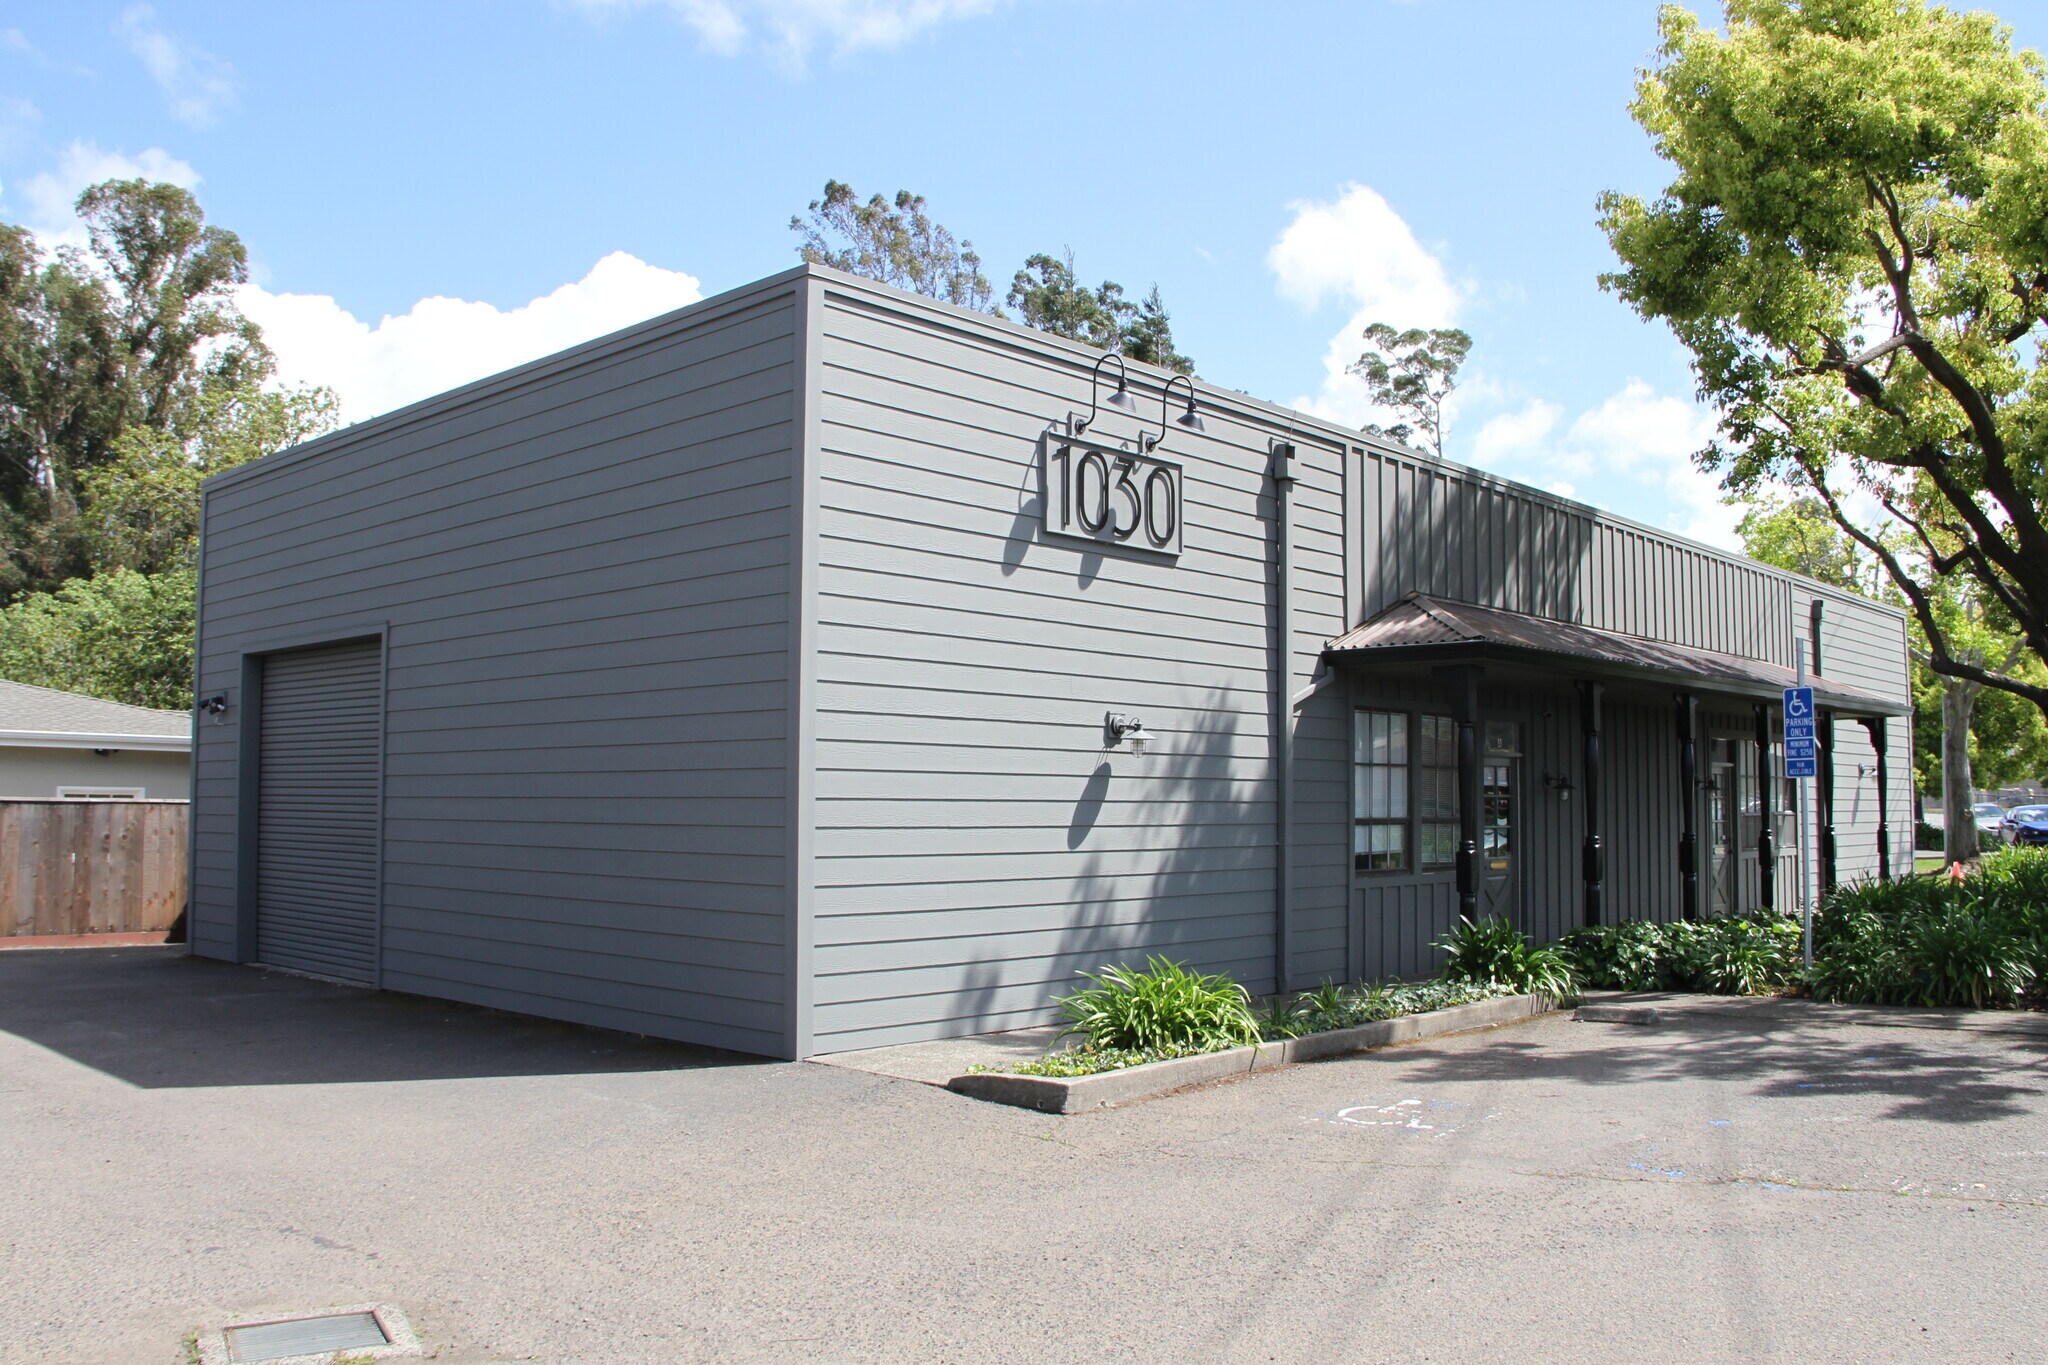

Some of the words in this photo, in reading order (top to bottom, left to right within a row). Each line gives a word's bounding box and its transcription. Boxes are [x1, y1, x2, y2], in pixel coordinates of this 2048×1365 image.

[1055, 444, 1176, 544] 1030
[1785, 717, 1813, 727] PARKING
[1790, 727, 1807, 737] ONLY
[1787, 748, 1798, 757] FINE
[1800, 748, 1813, 757] $250
